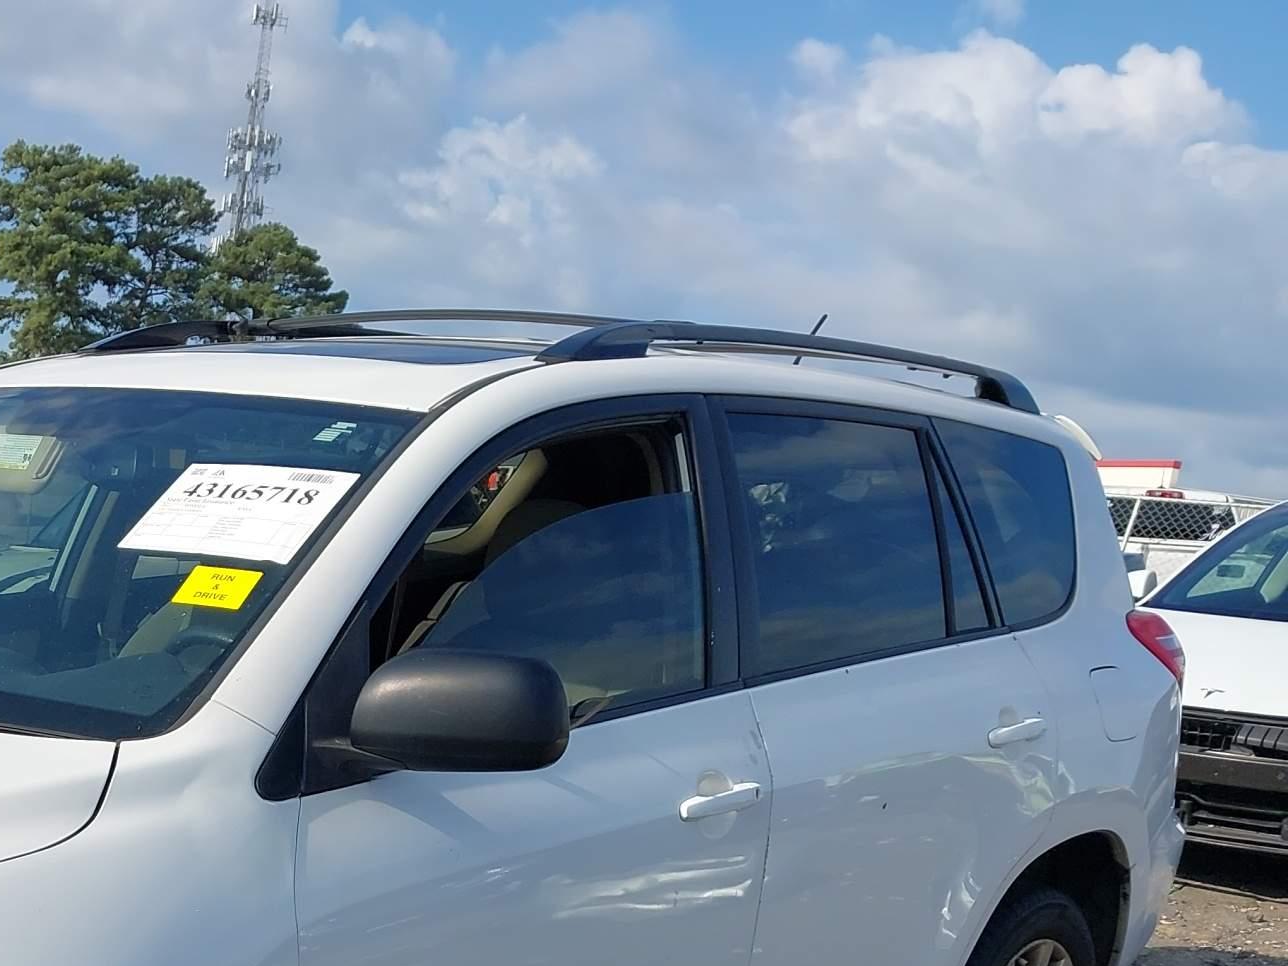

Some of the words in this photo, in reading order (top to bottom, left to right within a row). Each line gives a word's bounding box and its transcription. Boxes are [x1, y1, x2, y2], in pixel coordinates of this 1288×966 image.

[183, 482, 320, 506] 43165718
[210, 573, 236, 582] RUN
[211, 583, 221, 591] &
[192, 591, 229, 601] DRIVE
